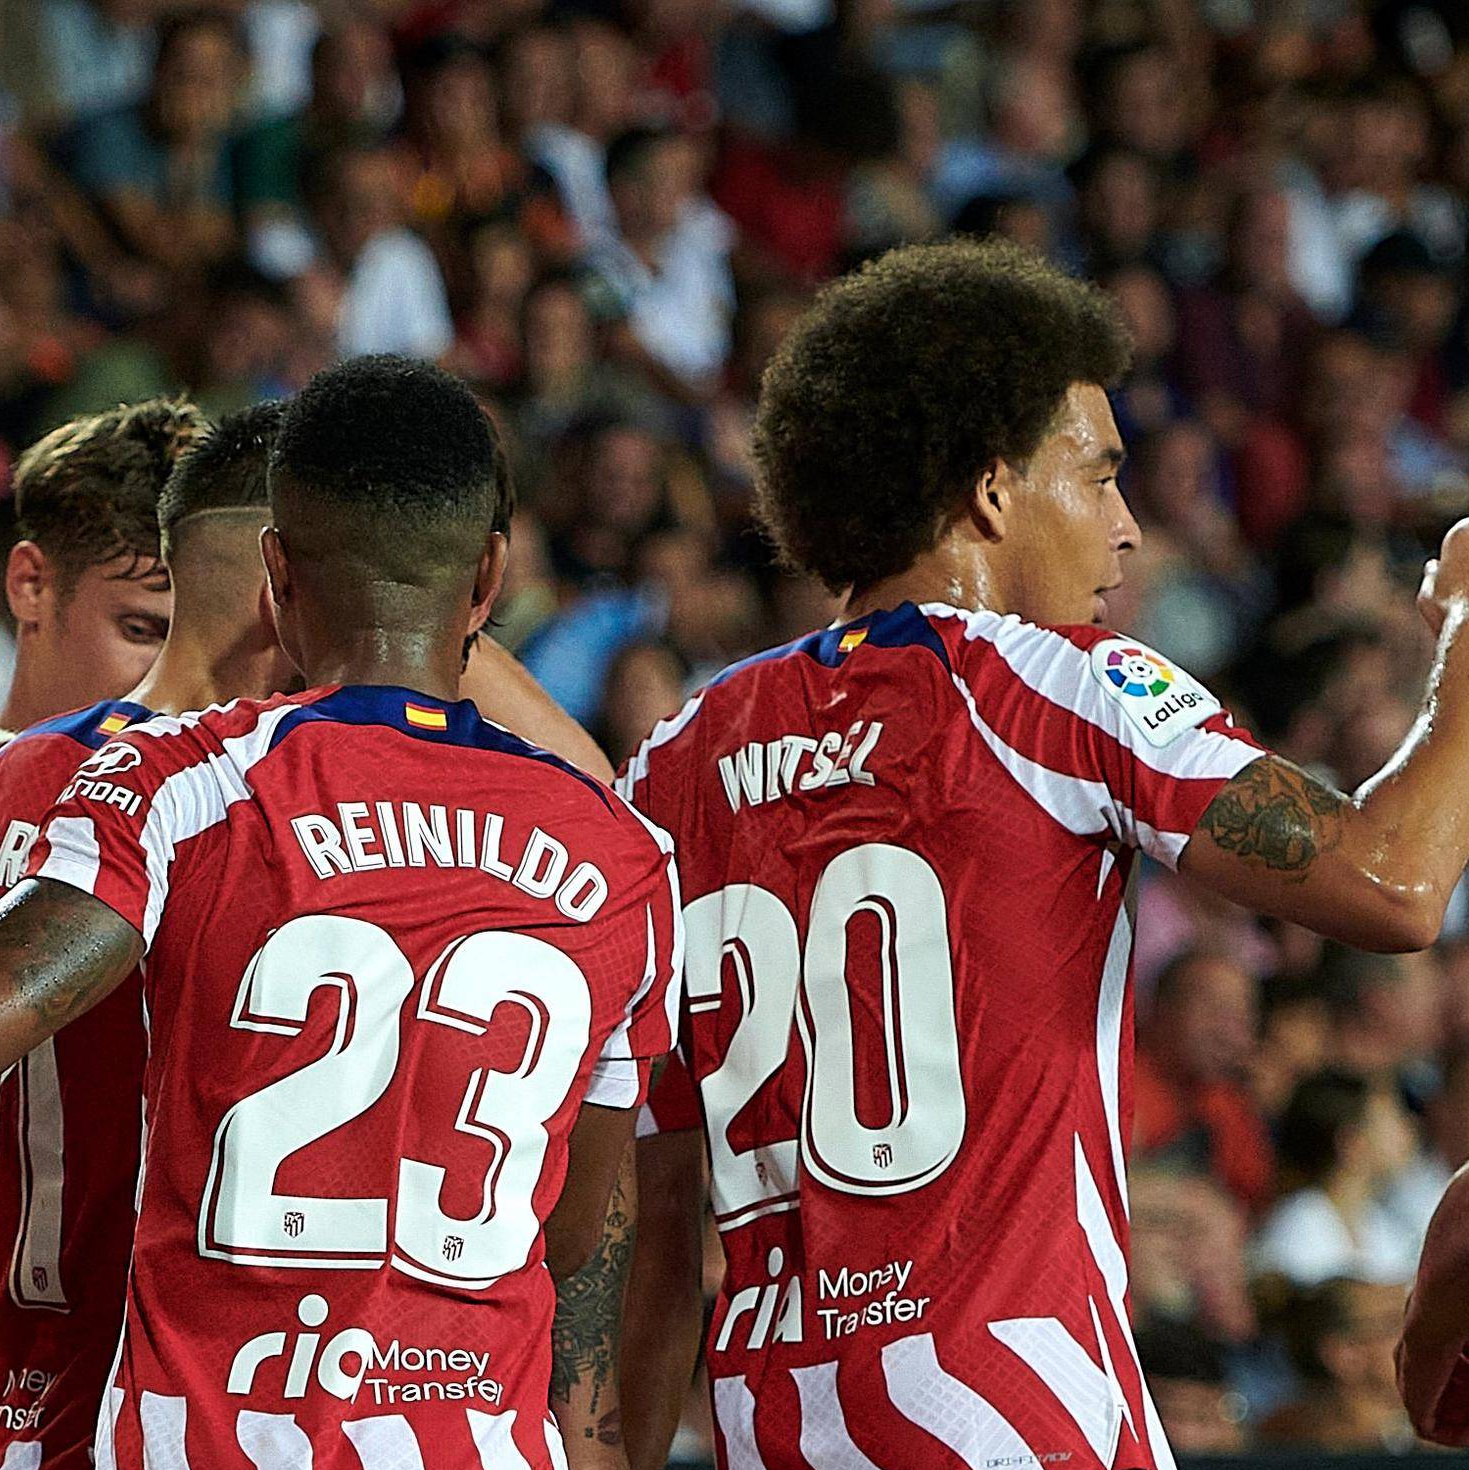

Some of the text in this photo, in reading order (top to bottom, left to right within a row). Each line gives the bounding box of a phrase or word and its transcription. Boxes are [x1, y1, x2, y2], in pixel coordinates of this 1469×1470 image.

[1143, 692, 1204, 730] LaLiga
[717, 720, 884, 815] WITSEL
[290, 800, 609, 923] REINILDO
[681, 842, 967, 1233] 20
[197, 913, 593, 1290] 23
[226, 1293, 490, 1405] ria Money
[715, 1246, 913, 1351] ria Money
